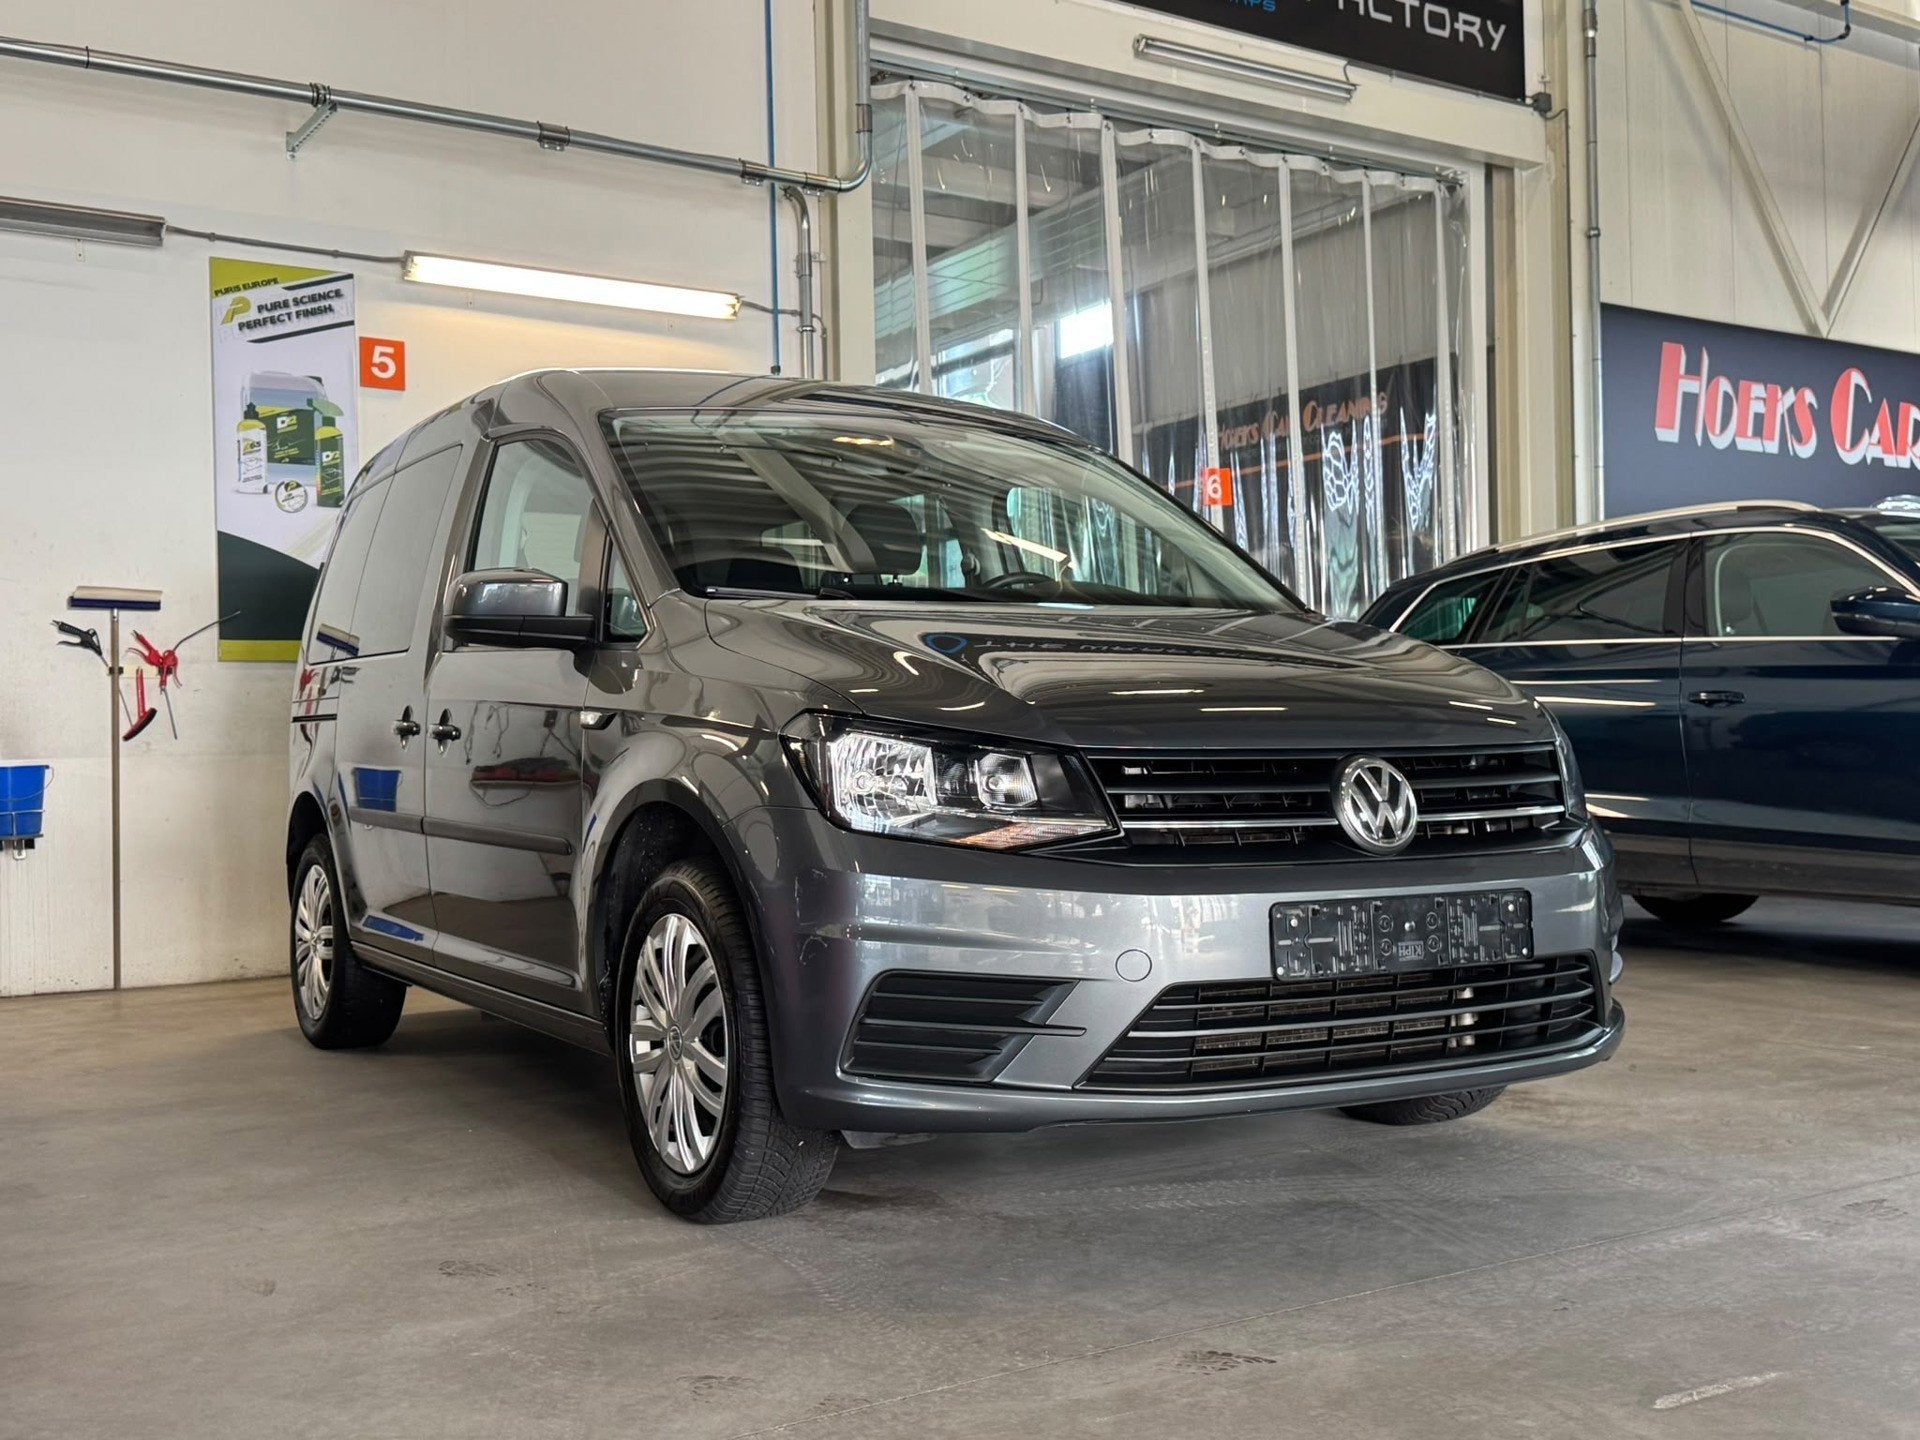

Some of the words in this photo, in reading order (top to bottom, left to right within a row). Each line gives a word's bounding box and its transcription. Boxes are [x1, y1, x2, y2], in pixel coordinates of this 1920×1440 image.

[214, 285, 242, 297] PURIS
[242, 277, 279, 291] EUROPE
[257, 300, 290, 314] PURE
[238, 312, 293, 331] PERFECT
[370, 345, 397, 379] 5
[1207, 476, 1222, 499] 6
